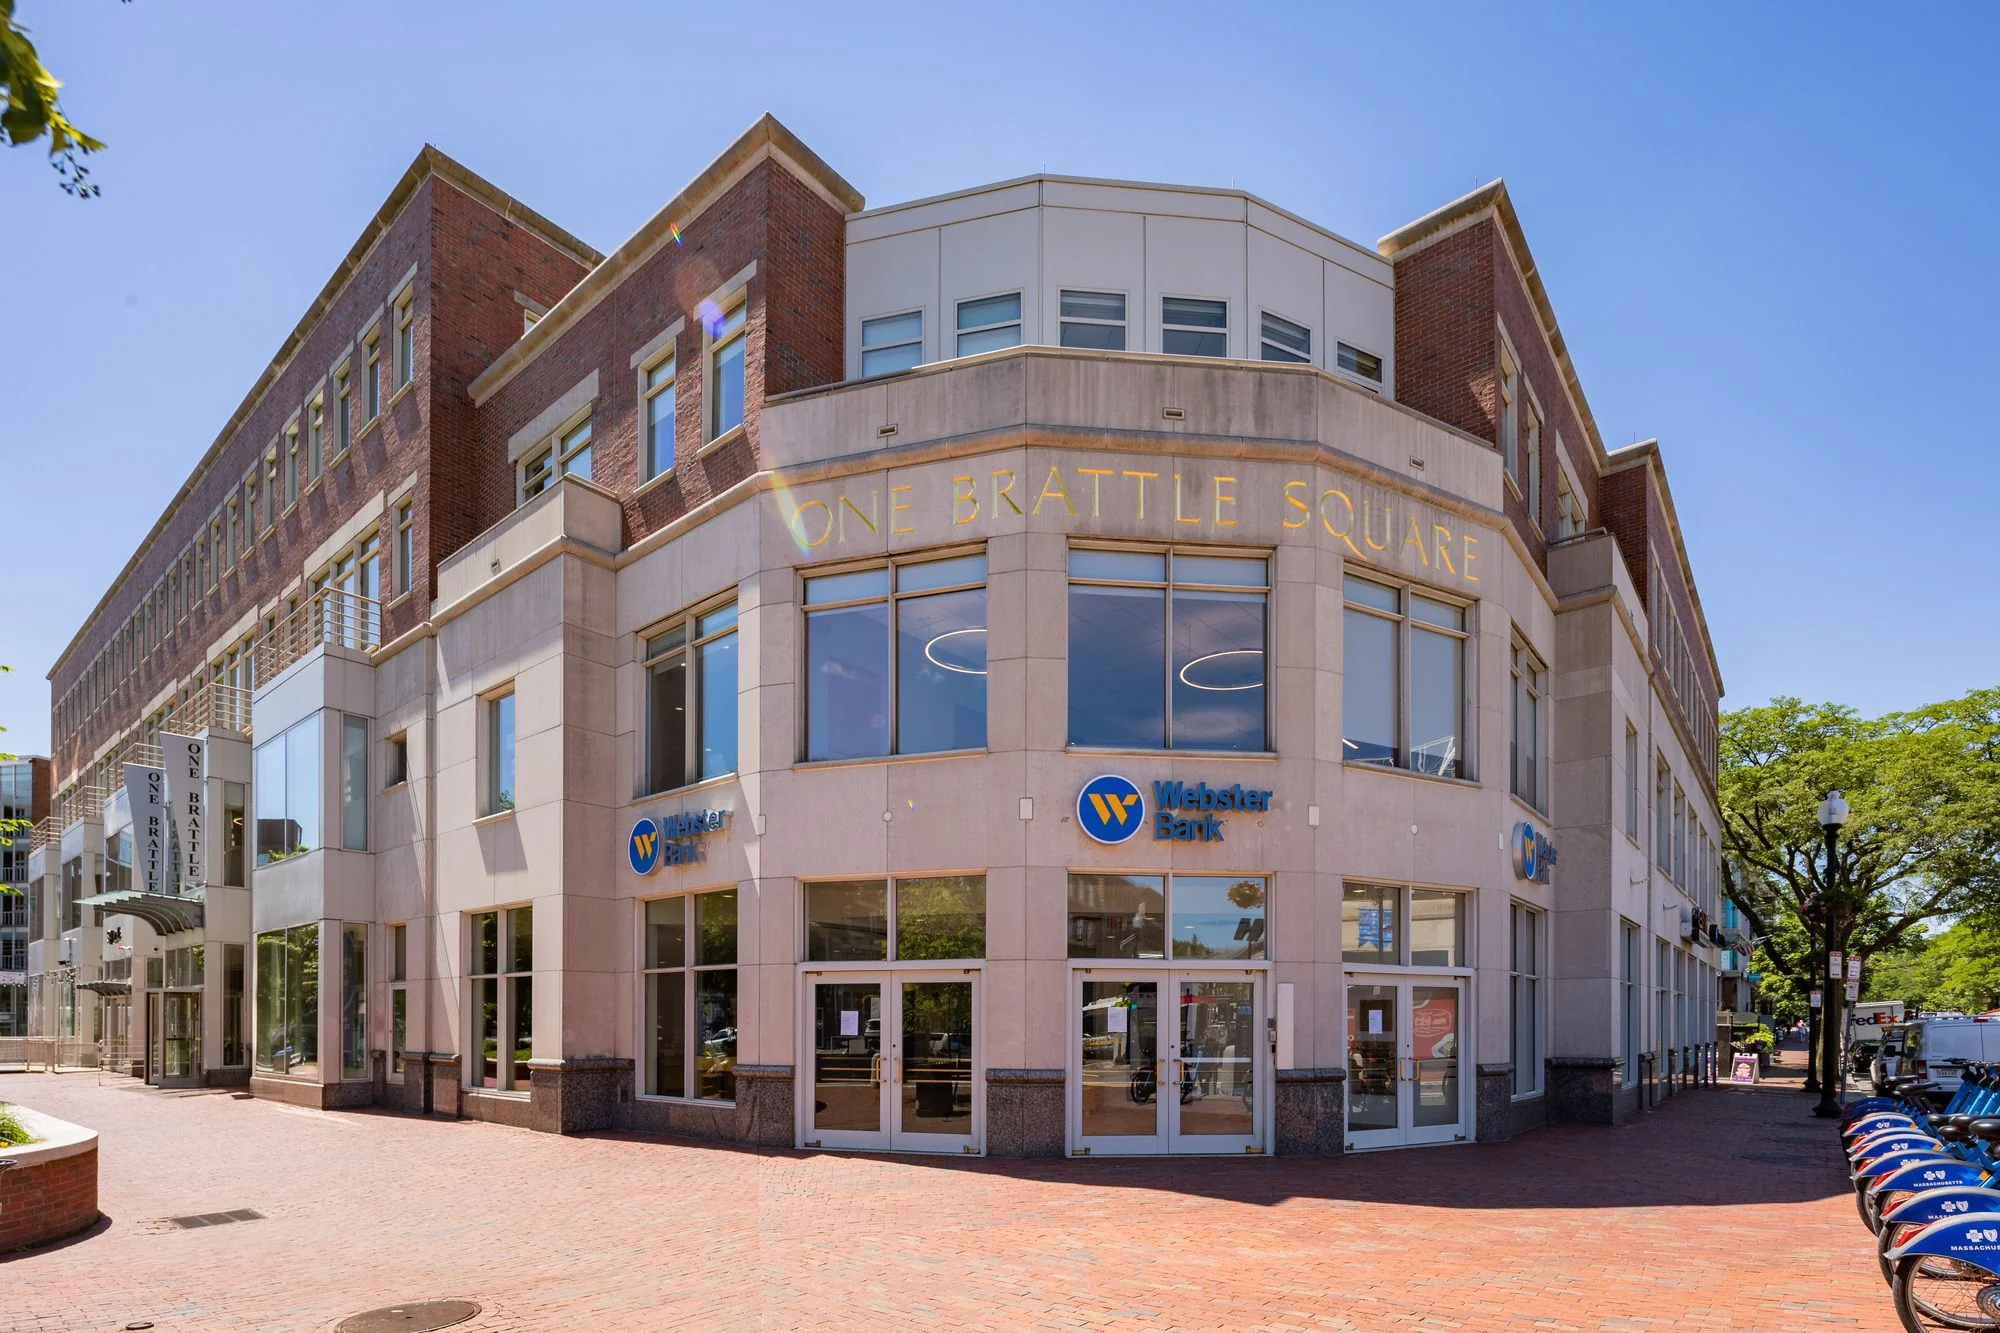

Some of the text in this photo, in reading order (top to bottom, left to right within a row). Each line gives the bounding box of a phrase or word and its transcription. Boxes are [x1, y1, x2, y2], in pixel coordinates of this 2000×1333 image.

[791, 466, 1480, 581] ONE BRATTLE SQUARE
[148, 772, 160, 892] ONE BRATTLE
[187, 743, 201, 877] ONE BRATTLE
[663, 809, 728, 840] Webster
[1152, 780, 1274, 812] Webster
[1152, 811, 1225, 842] Bank
